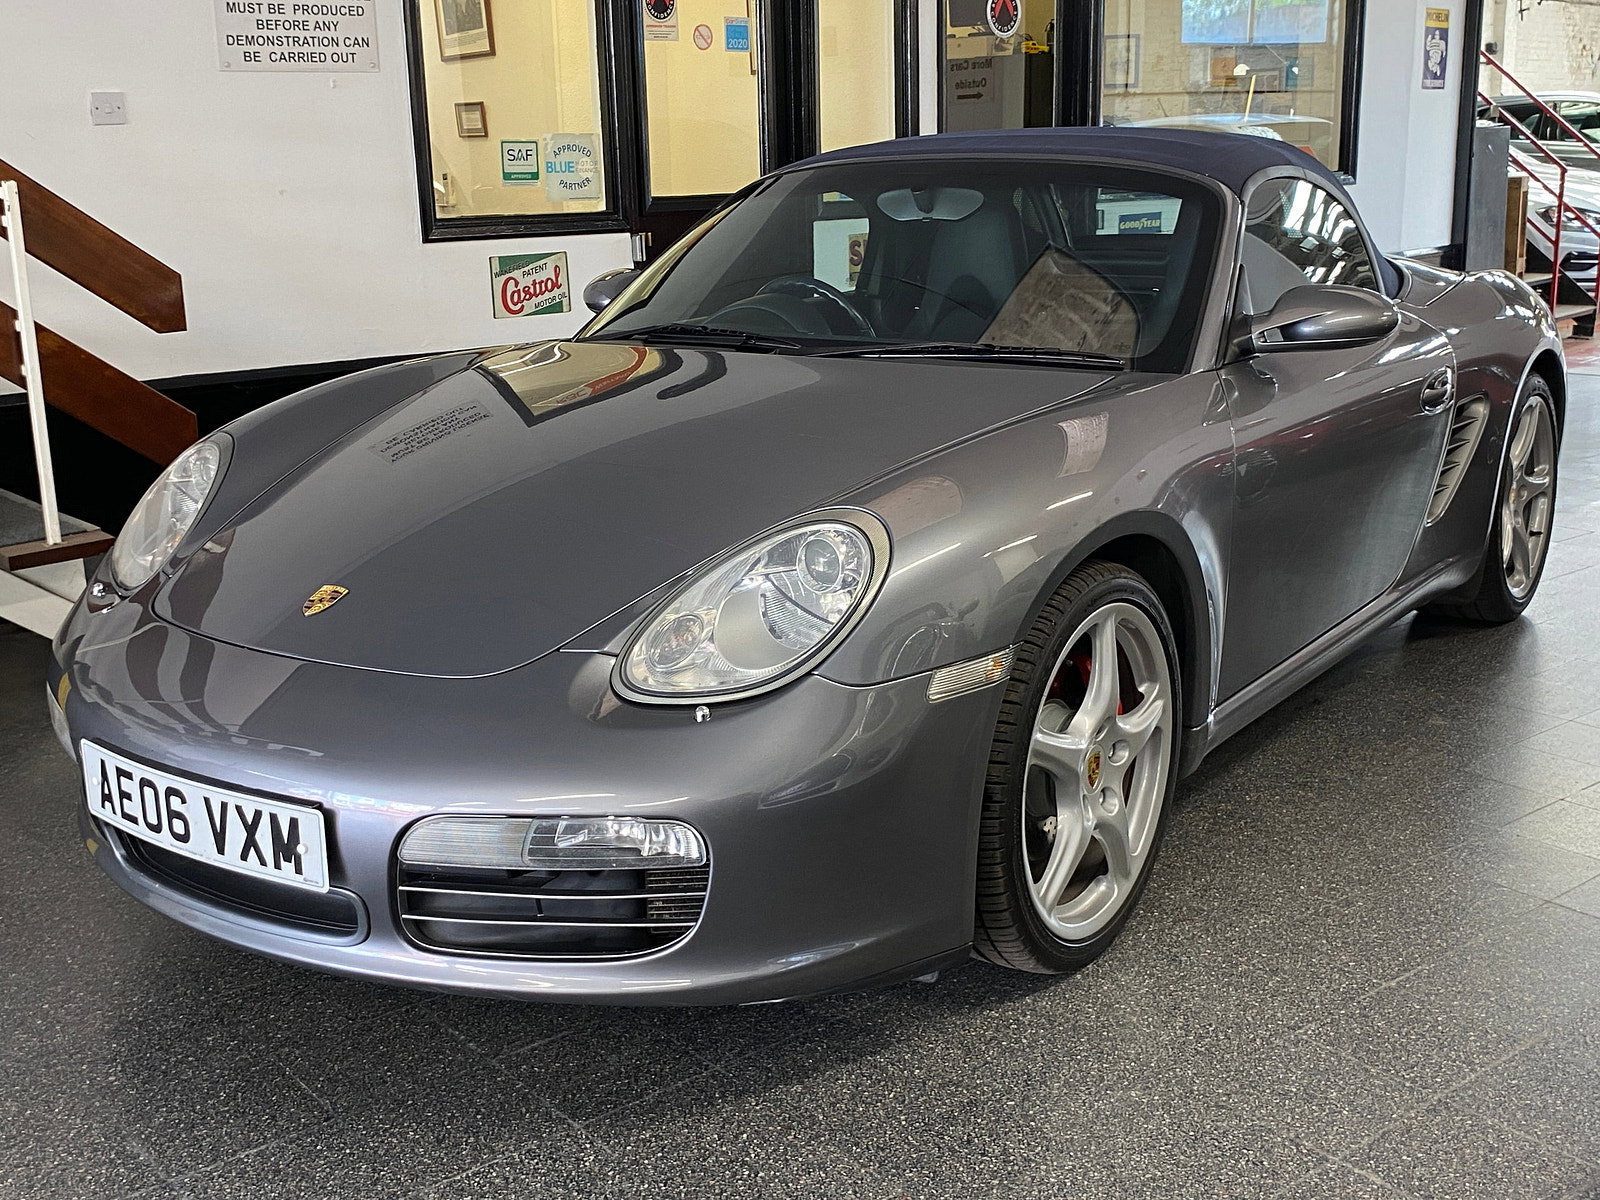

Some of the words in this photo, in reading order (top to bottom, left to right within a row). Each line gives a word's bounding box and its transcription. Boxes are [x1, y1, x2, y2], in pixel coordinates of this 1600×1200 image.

[226, 2, 264, 14] MUST
[268, 4, 285, 15] BE
[293, 4, 365, 17] PRODUCED
[256, 19, 310, 31] BEFORE
[313, 20, 339, 32] ANY
[226, 35, 340, 48] DEMONSTRATION
[343, 36, 370, 48] CAN
[728, 38, 748, 48] 2020
[243, 51, 262, 63] BE
[269, 52, 327, 63] CARRIED
[331, 52, 357, 64] OUT
[507, 149, 533, 161] SAF
[553, 143, 592, 158] APPROVED
[545, 161, 575, 174] BLUE
[559, 177, 592, 191] PARTNER
[1120, 217, 1160, 230] GOODYEAR
[522, 262, 548, 279] PATENT
[501, 265, 562, 315] Castrol
[534, 295, 557, 309] MOTOR
[557, 291, 568, 300] OIL
[100, 758, 190, 844] AE06
[203, 795, 304, 876] VXM
